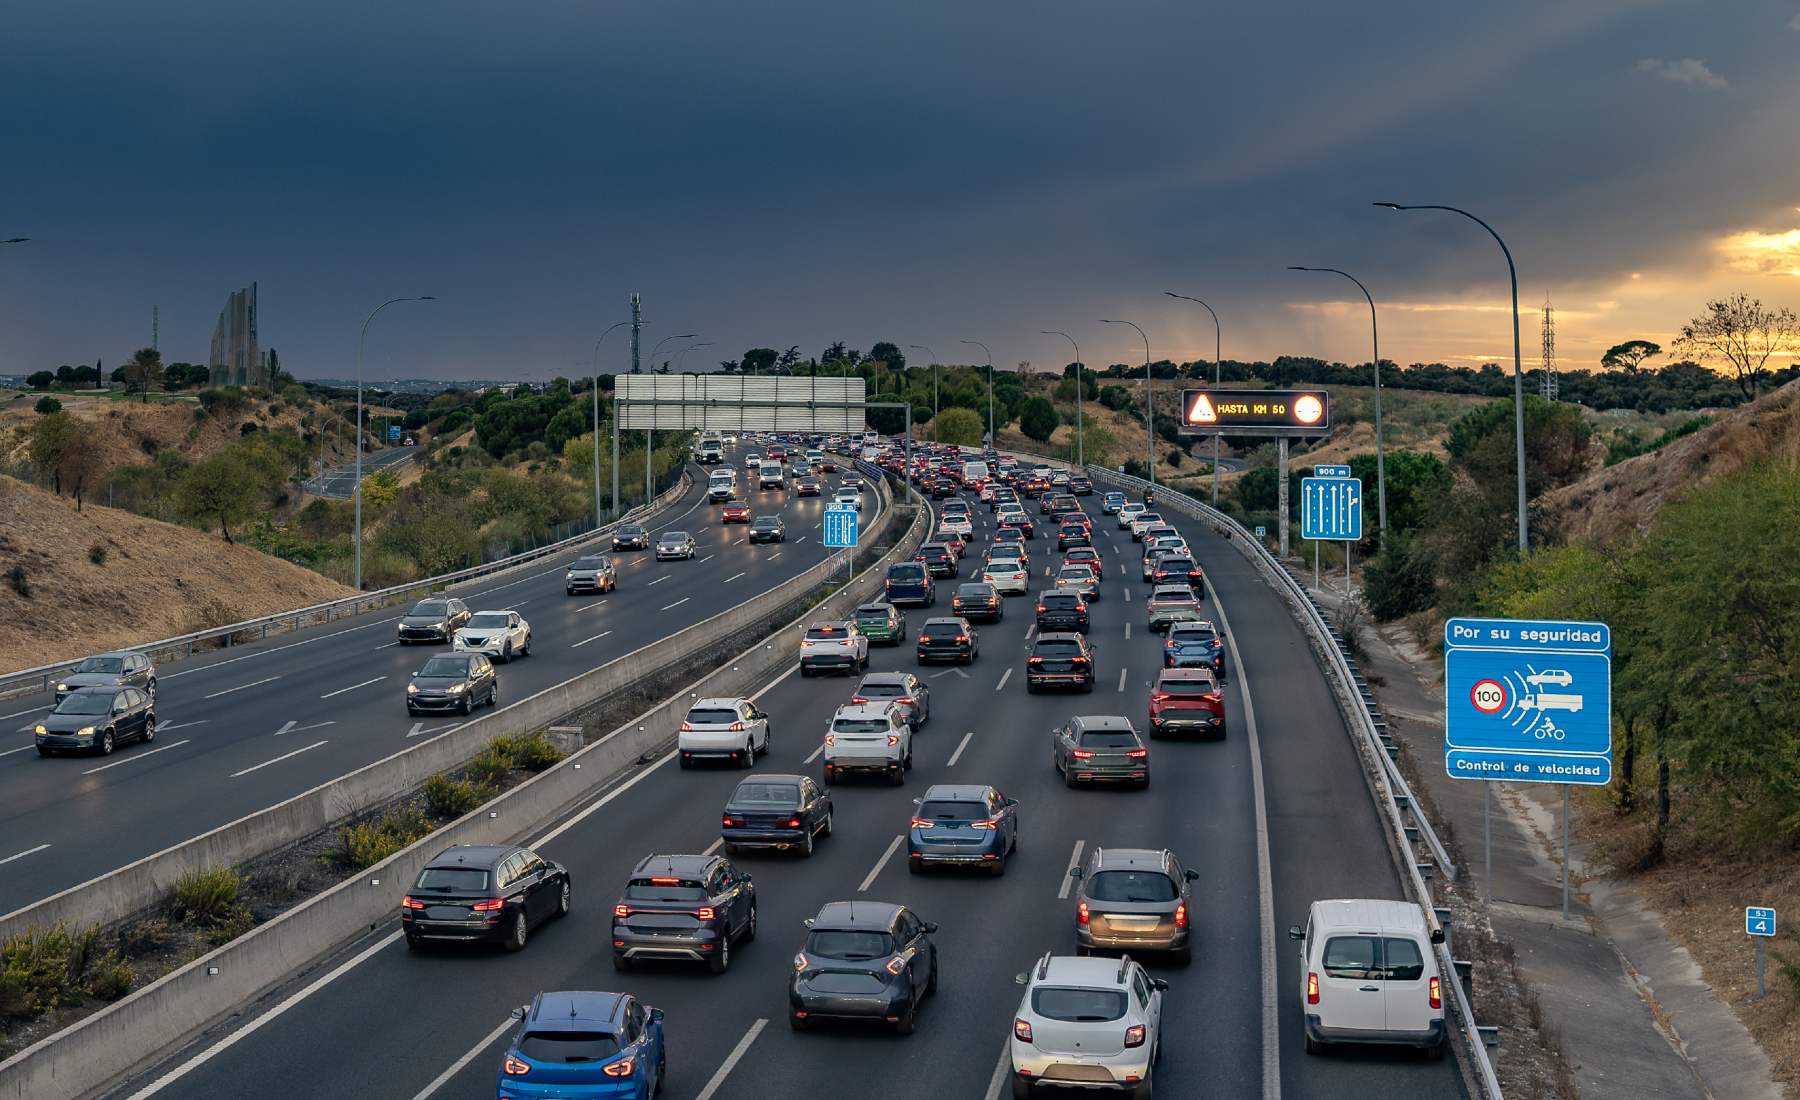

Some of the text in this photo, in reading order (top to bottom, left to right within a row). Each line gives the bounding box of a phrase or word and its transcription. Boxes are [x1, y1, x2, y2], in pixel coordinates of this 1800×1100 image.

[1217, 404, 1285, 414] HASTA KM 50
[1454, 625, 1601, 643] Por su seguridad
[1476, 691, 1501, 703] 100
[1456, 759, 1601, 776] Control de velocidad
[1754, 919, 1767, 933] 4
